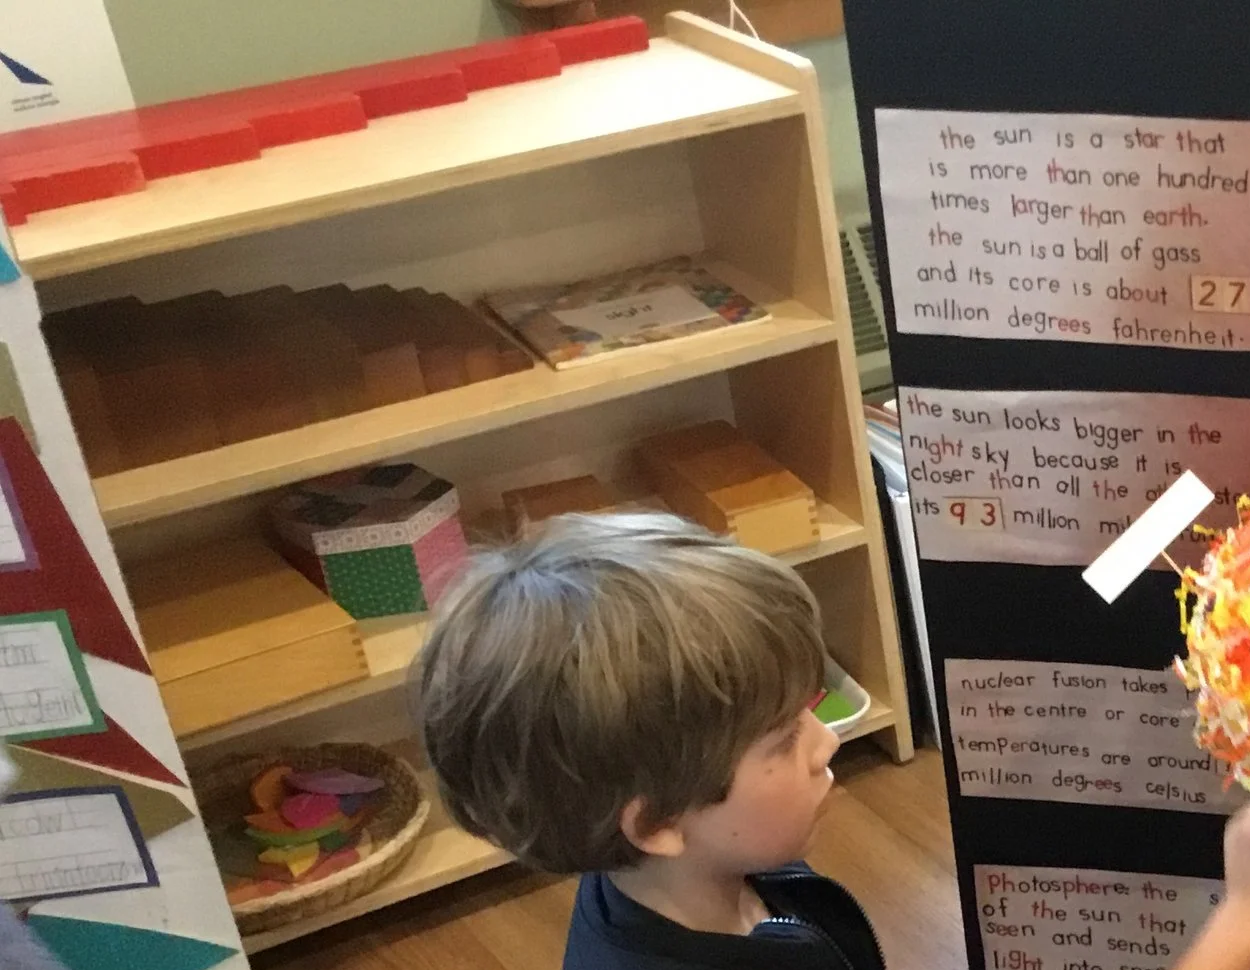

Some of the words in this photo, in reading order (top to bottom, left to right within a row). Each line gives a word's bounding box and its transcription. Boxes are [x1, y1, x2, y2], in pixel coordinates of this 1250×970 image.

[939, 125, 976, 151] the
[994, 127, 1032, 146] sun
[1056, 131, 1075, 148] is
[1089, 131, 1103, 148] a
[1124, 125, 1165, 149] star
[1176, 129, 1225, 155] that
[929, 161, 948, 177] is
[970, 166, 1027, 182] more
[1047, 160, 1091, 186] than
[1103, 170, 1140, 187] one
[1157, 164, 1249, 194] hundred
[931, 192, 990, 213] times
[1011, 194, 1074, 224] larger
[1080, 206, 1126, 226] than
[1143, 207, 1209, 226] earth.
[928, 223, 963, 247] the
[982, 237, 1022, 256] sun
[1031, 242, 1047, 259] is
[1052, 243, 1065, 259] a
[1074, 237, 1109, 263] ball
[1121, 237, 1143, 261] of
[1152, 246, 1201, 270] gass
[917, 261, 957, 283] and
[968, 265, 994, 286] its
[1008, 276, 1060, 294] core
[1072, 280, 1092, 297] is
[1106, 279, 1167, 303] about
[1198, 280, 1246, 307] 27
[914, 301, 990, 321] million
[1007, 309, 1092, 335] degrees
[1112, 318, 1244, 347] fahrenheit.
[908, 394, 943, 419] the
[952, 406, 991, 426] sun
[1005, 408, 1061, 433] looks
[1074, 417, 1143, 449] bigger
[1157, 422, 1175, 444] in
[1188, 422, 1222, 444] the
[910, 434, 964, 465] night
[972, 446, 1010, 469] sky
[1033, 447, 1119, 470] because
[1136, 454, 1148, 474] it
[1165, 459, 1183, 476] is
[911, 466, 975, 485] closer
[989, 473, 1041, 490] than
[1056, 477, 1080, 497] all
[1093, 479, 1129, 499] the
[915, 497, 940, 516] its
[950, 503, 997, 527] 93
[1013, 509, 1080, 532] million
[961, 671, 1036, 689] nuclear
[1052, 671, 1106, 690] fusion
[1122, 678, 1168, 694] takes
[960, 704, 977, 717] in
[988, 702, 1015, 717] the
[1024, 703, 1087, 718] centre
[1104, 708, 1125, 721] or
[1140, 712, 1180, 728] core
[1101, 752, 1131, 766] are
[1148, 755, 1210, 773] around
[961, 769, 1032, 785] million
[1052, 770, 1122, 793] degrees
[1145, 781, 1206, 804] celsius
[1141, 883, 1177, 902] the
[982, 898, 1007, 918] of
[1031, 901, 1067, 922] the
[1079, 908, 1121, 923] sun
[1139, 913, 1187, 936] that
[985, 920, 1035, 937] seen
[1052, 927, 1093, 946] and
[1107, 935, 1170, 956] sends
